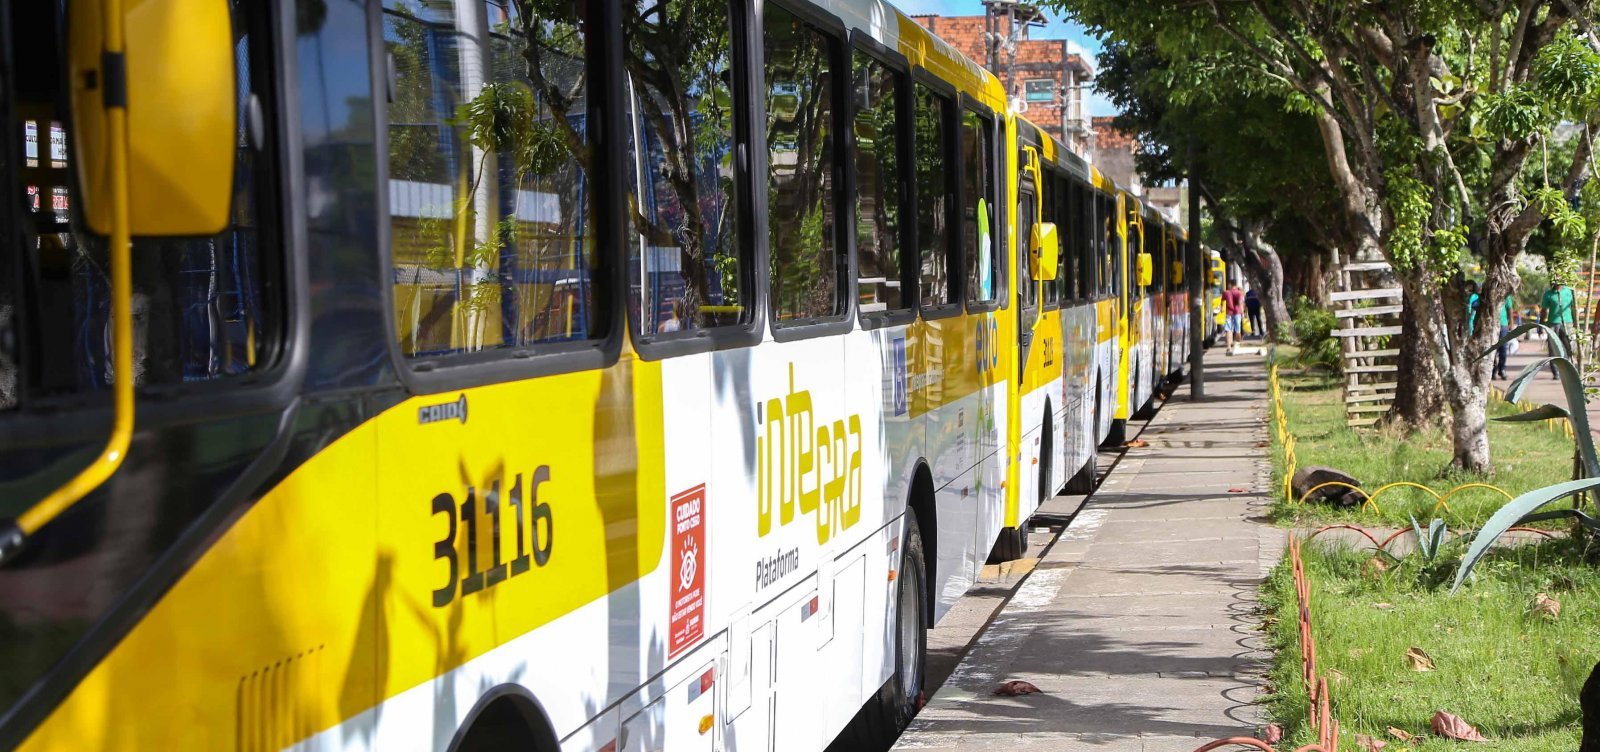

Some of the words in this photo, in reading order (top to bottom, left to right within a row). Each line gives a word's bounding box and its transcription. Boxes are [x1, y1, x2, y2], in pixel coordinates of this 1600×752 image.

[418, 401, 460, 425] CAIO
[676, 497, 700, 522] CUIDADO
[431, 464, 553, 608] 31116
[755, 546, 799, 592] Plataforma
